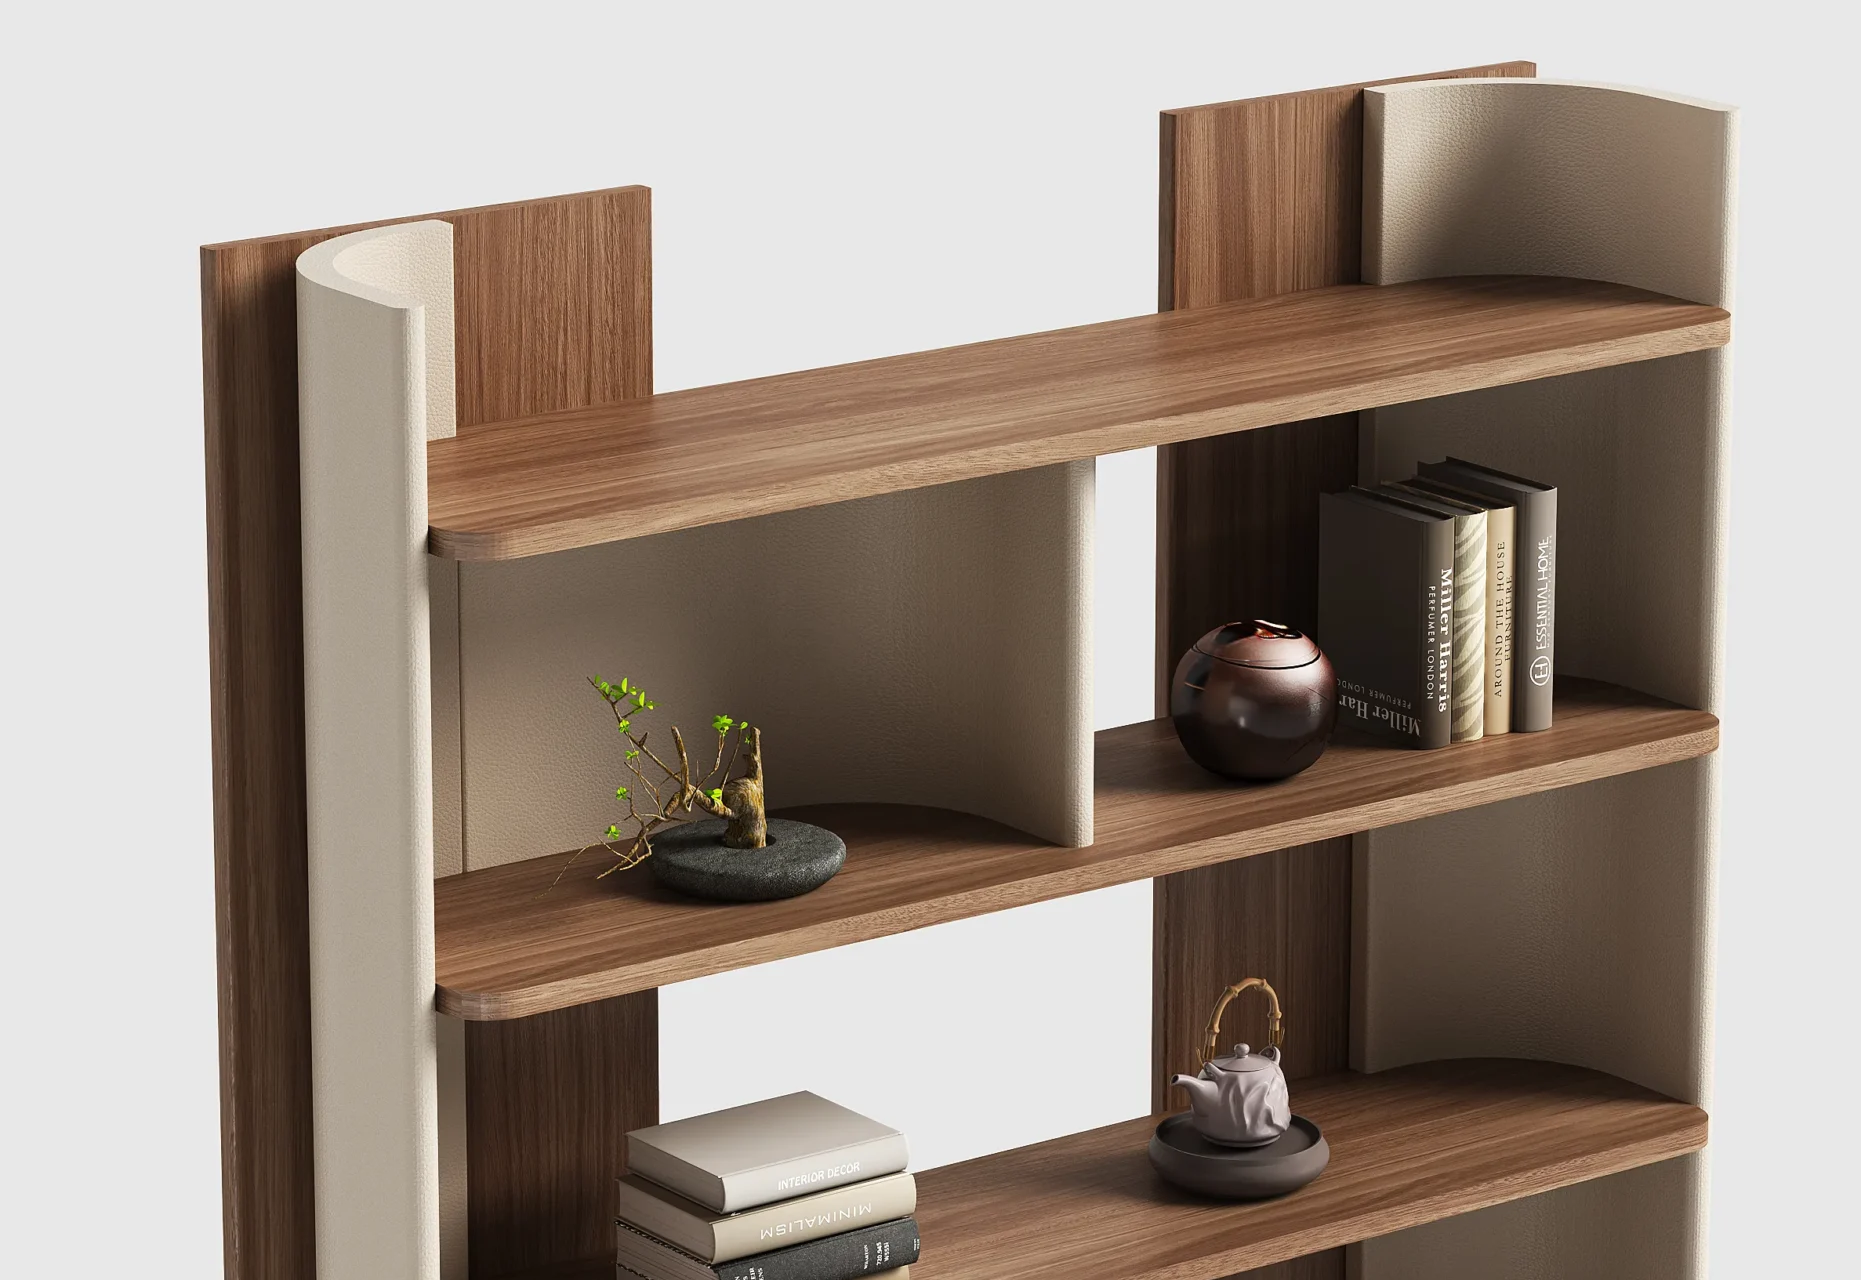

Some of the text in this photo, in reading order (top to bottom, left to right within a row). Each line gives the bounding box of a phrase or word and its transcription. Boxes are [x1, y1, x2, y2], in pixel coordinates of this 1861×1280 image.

[1494, 541, 1505, 697] AROUND THE HOUSE
[1504, 575, 1513, 661] FURNITURE
[1536, 536, 1549, 650] ESSENTIAL HOME
[1426, 585, 1436, 699] PERFUMER LONDON
[1438, 567, 1452, 712] Miller Harris
[1369, 689, 1411, 710] PERFUMER
[1372, 705, 1421, 737] Miller
[778, 1161, 860, 1191] INTERIOR DECOR
[760, 1202, 872, 1240] MINIMALISM
